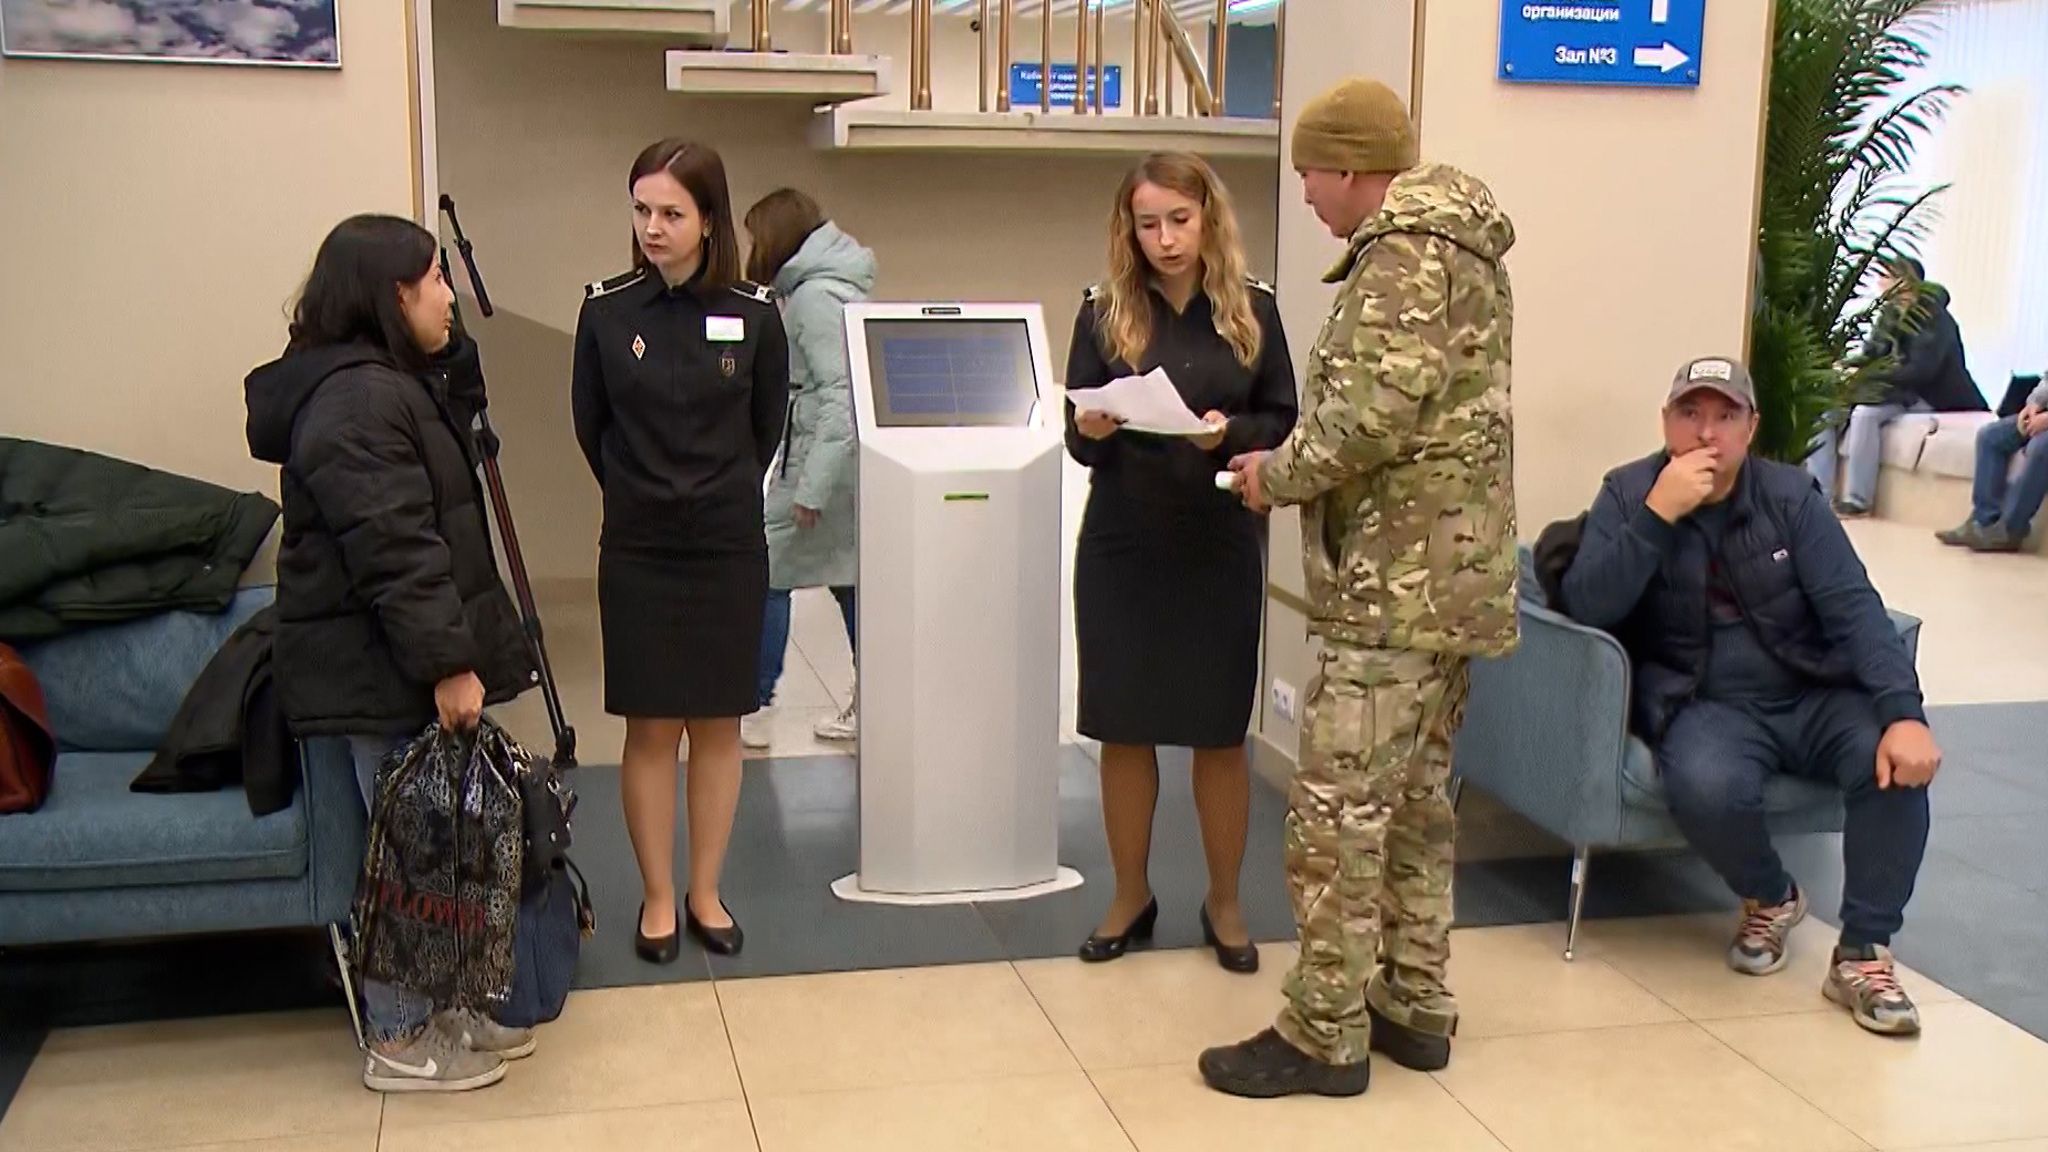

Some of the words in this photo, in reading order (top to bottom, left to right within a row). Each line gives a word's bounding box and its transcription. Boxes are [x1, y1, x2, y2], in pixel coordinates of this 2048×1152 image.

[1522, 5, 1620, 21] организации
[1555, 46, 1585, 64] Зал
[1589, 47, 1616, 64] №3
